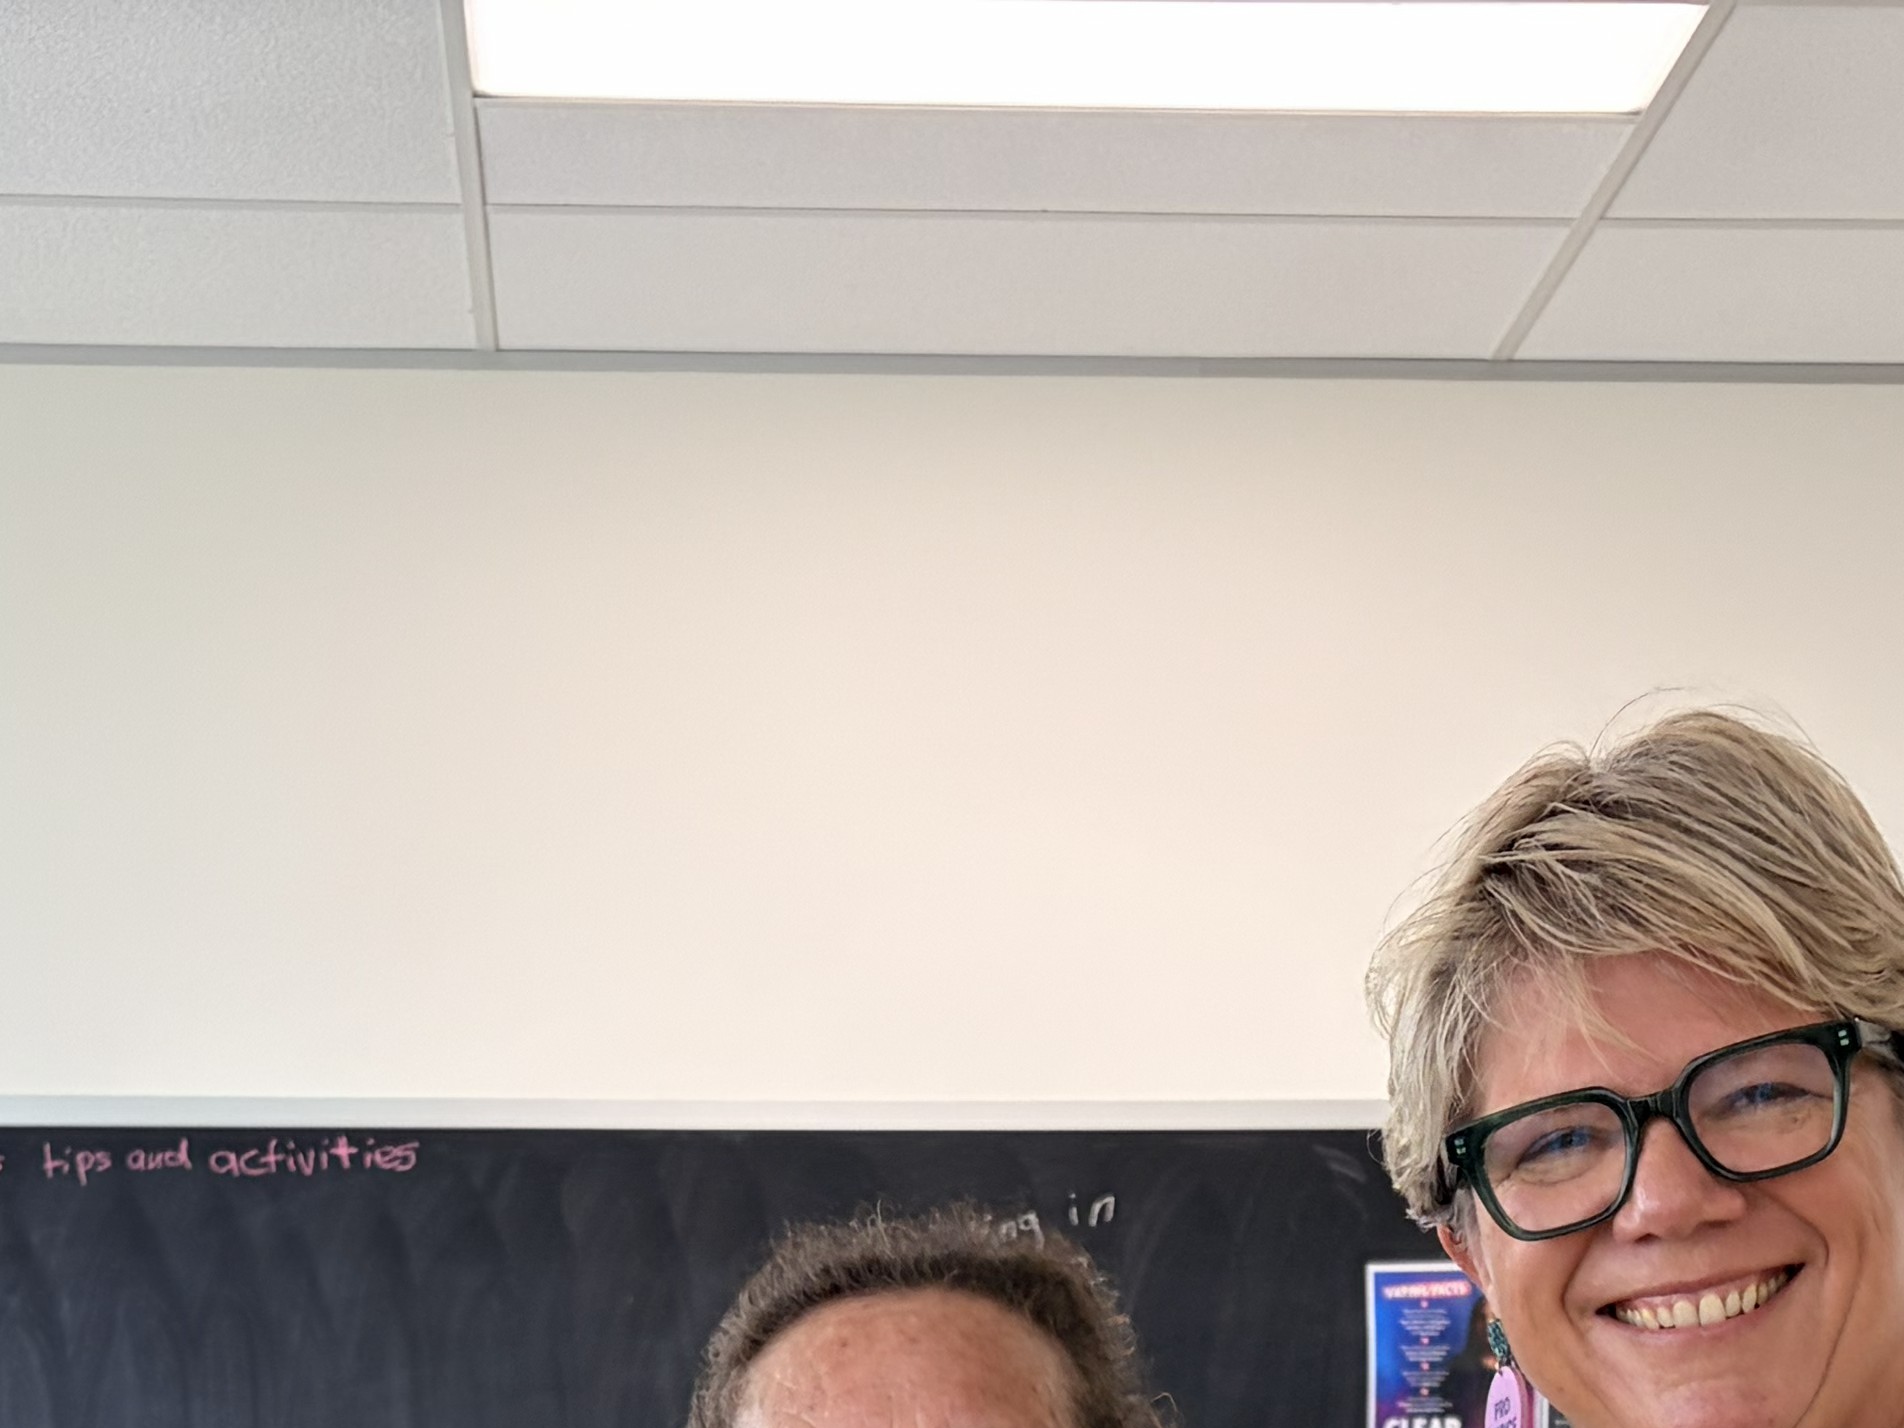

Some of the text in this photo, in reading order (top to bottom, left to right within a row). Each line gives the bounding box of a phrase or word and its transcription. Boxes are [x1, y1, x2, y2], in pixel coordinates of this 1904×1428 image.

[41, 1142, 112, 1187] tips
[126, 1137, 193, 1171] and
[207, 1134, 421, 1178] activities
[1067, 1191, 1116, 1228] in
